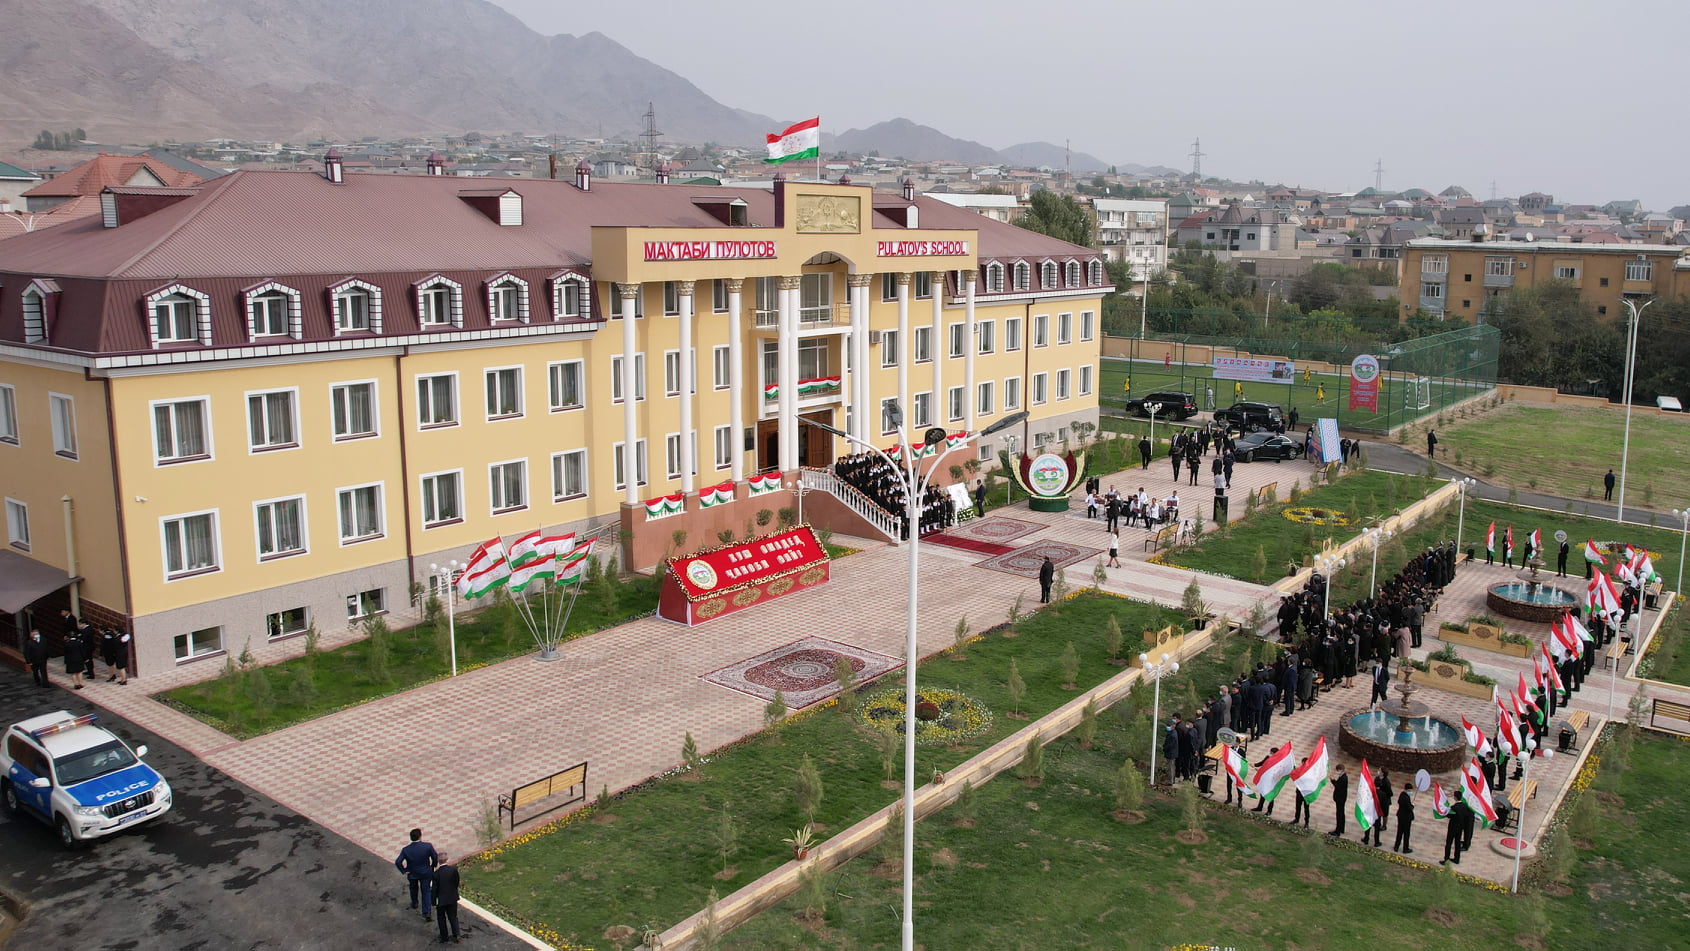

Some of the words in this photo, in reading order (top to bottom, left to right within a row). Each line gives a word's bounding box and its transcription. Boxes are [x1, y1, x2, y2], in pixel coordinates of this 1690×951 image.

[644, 241, 711, 259] МАКТАБИ
[716, 241, 775, 257] ПУЛОТОВ
[878, 241, 927, 255] PULATOV'S
[931, 241, 966, 255] SCHOOL
[728, 549, 752, 563] ХУШ
[96, 780, 149, 801] POLICE
